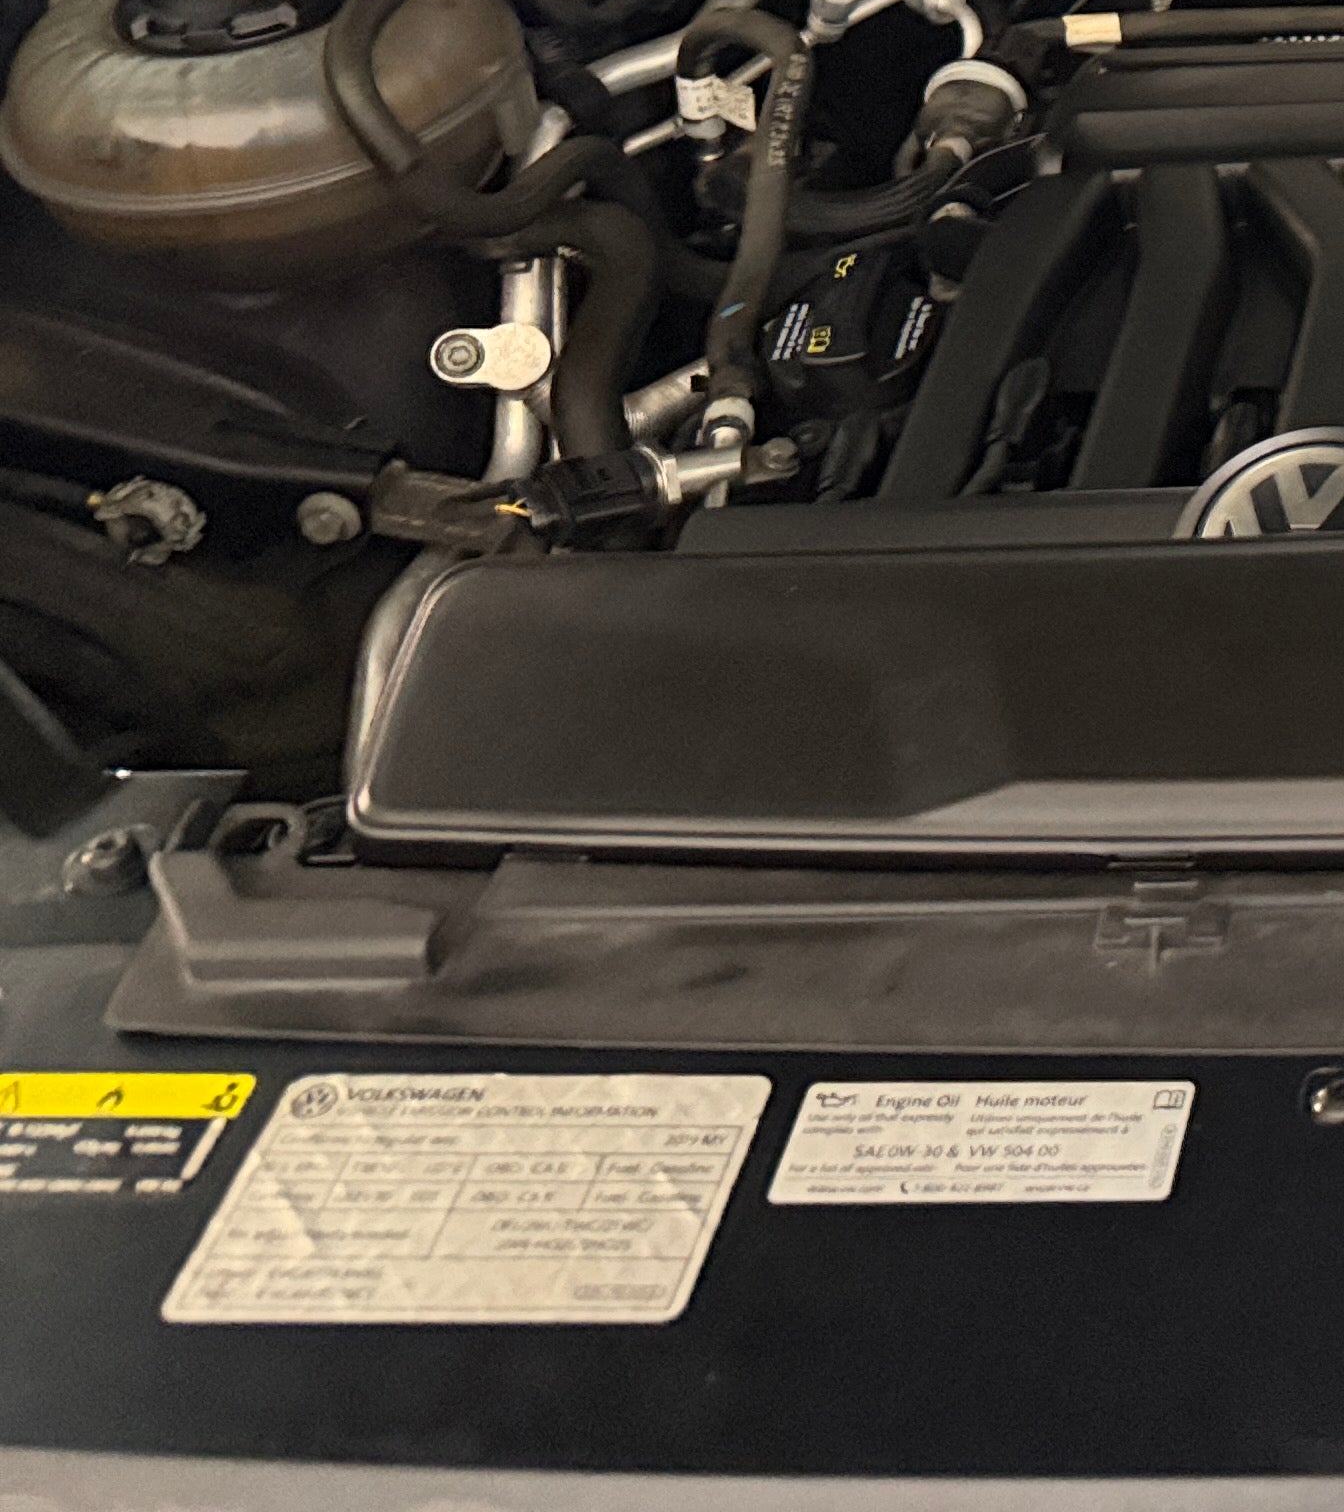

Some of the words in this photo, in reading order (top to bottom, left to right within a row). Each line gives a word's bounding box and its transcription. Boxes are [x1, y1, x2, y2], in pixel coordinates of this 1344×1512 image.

[341, 1087, 487, 1101] VOLKSWAGEN
[974, 1094, 1021, 1107] Huile
[1022, 1094, 1088, 1106] moteur
[873, 1094, 933, 1109] Engine
[935, 1094, 961, 1107] Oil
[548, 1105, 660, 1117] INFORMATION
[851, 1144, 888, 1158] SAE
[945, 1144, 961, 1158] &
[966, 1144, 1000, 1157] VW
[1001, 1144, 1035, 1157] 504
[1036, 1144, 1062, 1157] 00
